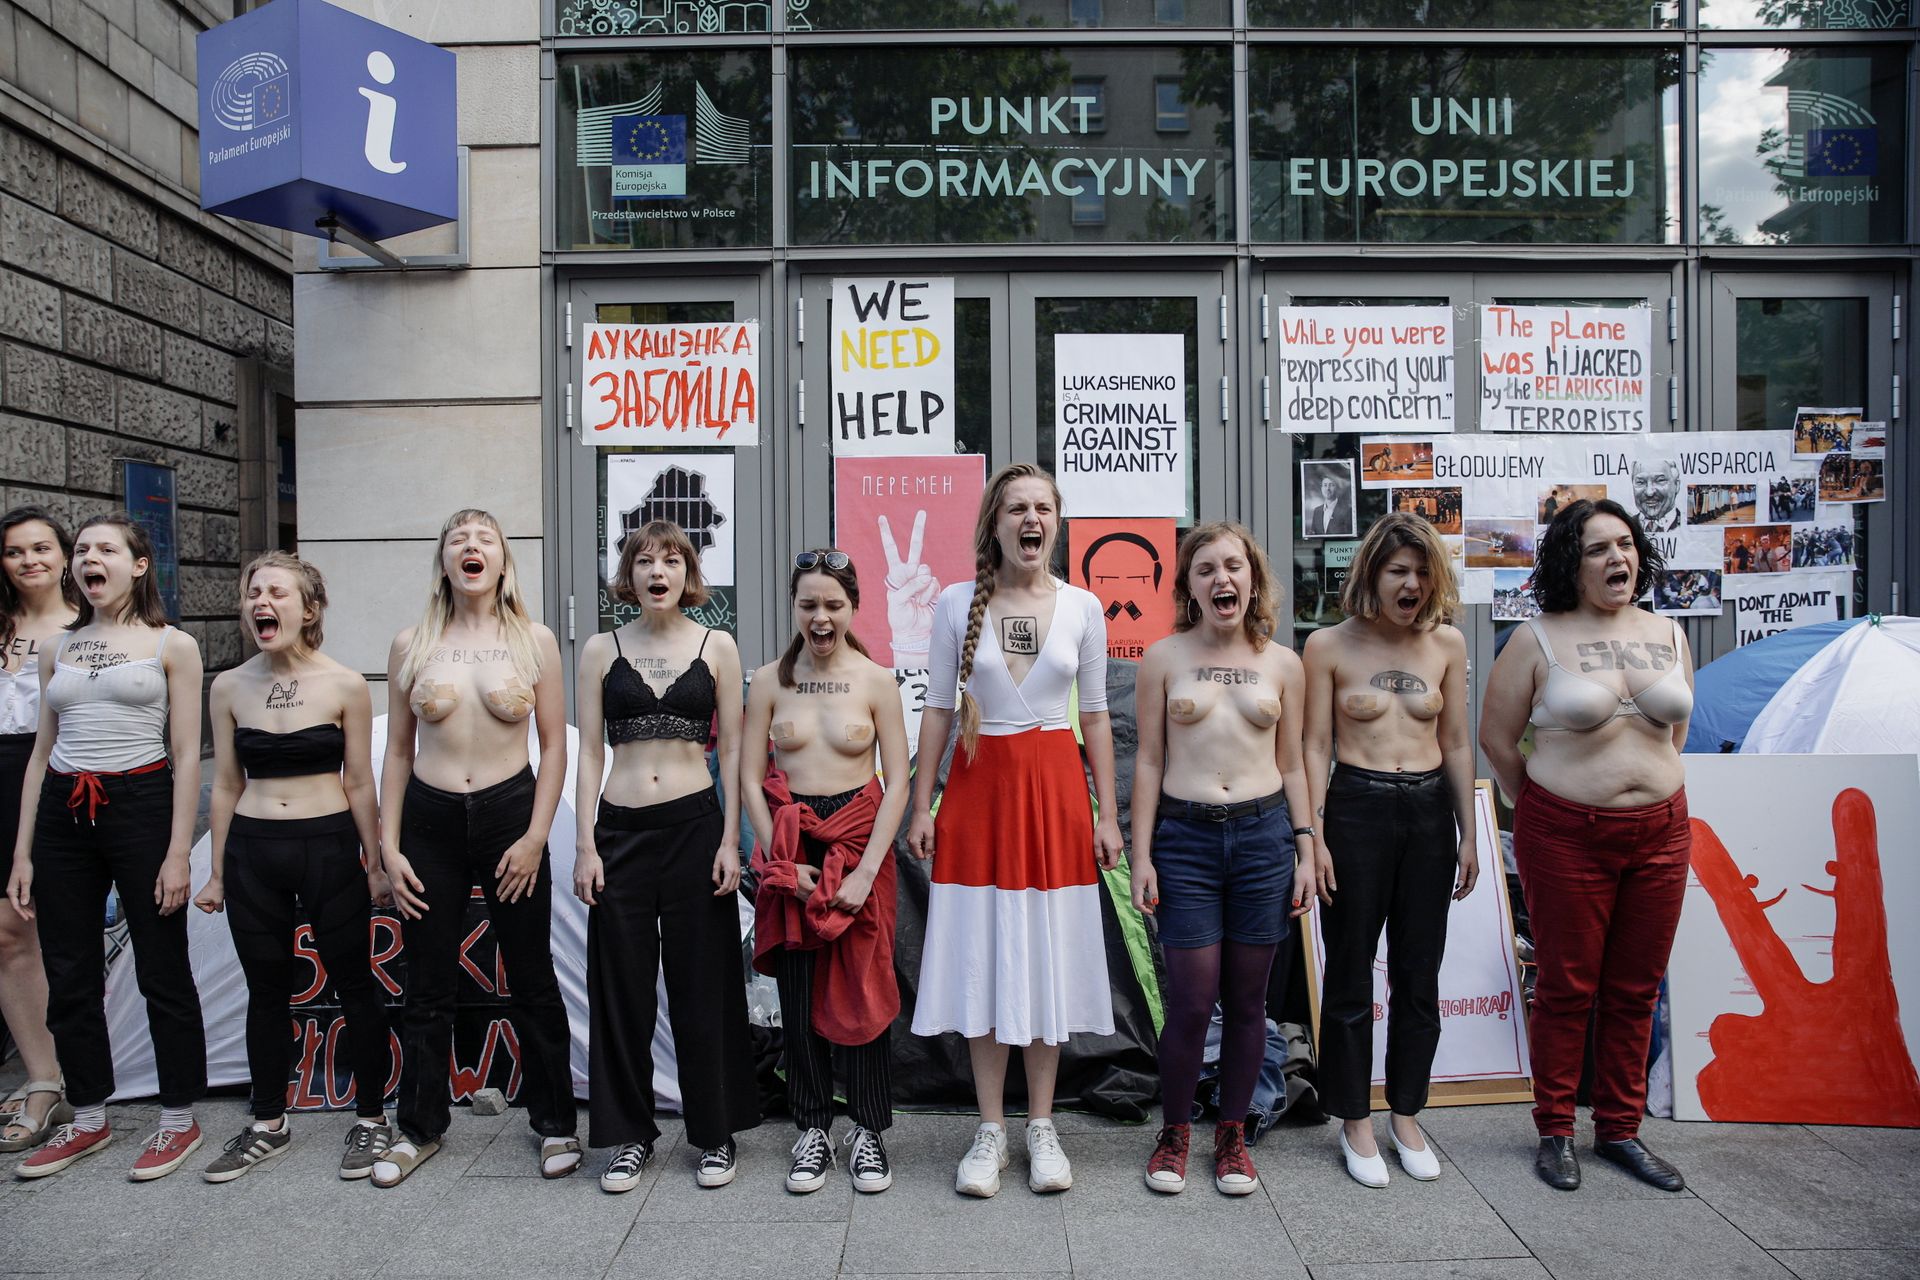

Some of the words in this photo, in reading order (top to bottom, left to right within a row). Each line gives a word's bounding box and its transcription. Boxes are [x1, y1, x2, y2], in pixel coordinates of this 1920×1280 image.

[931, 96, 1096, 135] PUNKT
[1411, 97, 1512, 135] UNII
[209, 140, 249, 165] Parlament
[250, 124, 291, 152] Europejski
[615, 169, 653, 181] Komisja
[810, 157, 1207, 199] INFORMACYJNY
[1290, 157, 1635, 198] EUROPEJSKIEJ
[615, 181, 667, 192] Europejska
[1800, 185, 1879, 206] Europejski
[592, 209, 688, 220] Przedstawicielstwo
[691, 210, 700, 218] w
[703, 208, 736, 218] Polsce
[848, 279, 930, 323] WE
[1488, 307, 1533, 338] The
[588, 325, 753, 360] ЛУКАШЭНКА
[840, 326, 941, 373] NEED
[1342, 326, 1383, 358] you
[1391, 325, 1446, 345] were
[1483, 352, 1534, 375] was
[1063, 375, 1176, 390] LUKASHENKO
[1406, 354, 1454, 395] your
[589, 360, 756, 440] ЗАБОЙЦА
[1062, 393, 1071, 402] IS
[1073, 393, 1081, 402] A
[1483, 375, 1501, 410] by
[1503, 376, 1531, 400] the
[837, 390, 944, 440] HELP
[1063, 403, 1177, 425] CRIMINAL
[1288, 385, 1344, 432] deep
[1062, 427, 1177, 451] AGAINST
[1063, 452, 1178, 473] HUMANITY
[1435, 455, 1545, 478] GŁODUJEMY
[1593, 453, 1629, 476] DLA
[1680, 450, 1776, 475] WSPARCIA
[862, 475, 952, 496] ПЕРЕМЕН
[1738, 594, 1775, 612] DONT
[1778, 591, 1831, 609] ADMIT
[1759, 609, 1793, 624] THE
[68, 640, 108, 653] BRITISH
[1010, 640, 1033, 651] YARA
[1107, 646, 1144, 658] HITLER
[75, 652, 129, 663] AMERICAN
[634, 658, 667, 669] PHILIP
[648, 669, 682, 680] MORRIS
[1379, 678, 1424, 692] IKEA
[796, 681, 850, 694] SIEMENS
[266, 700, 304, 709] MICHELIN
